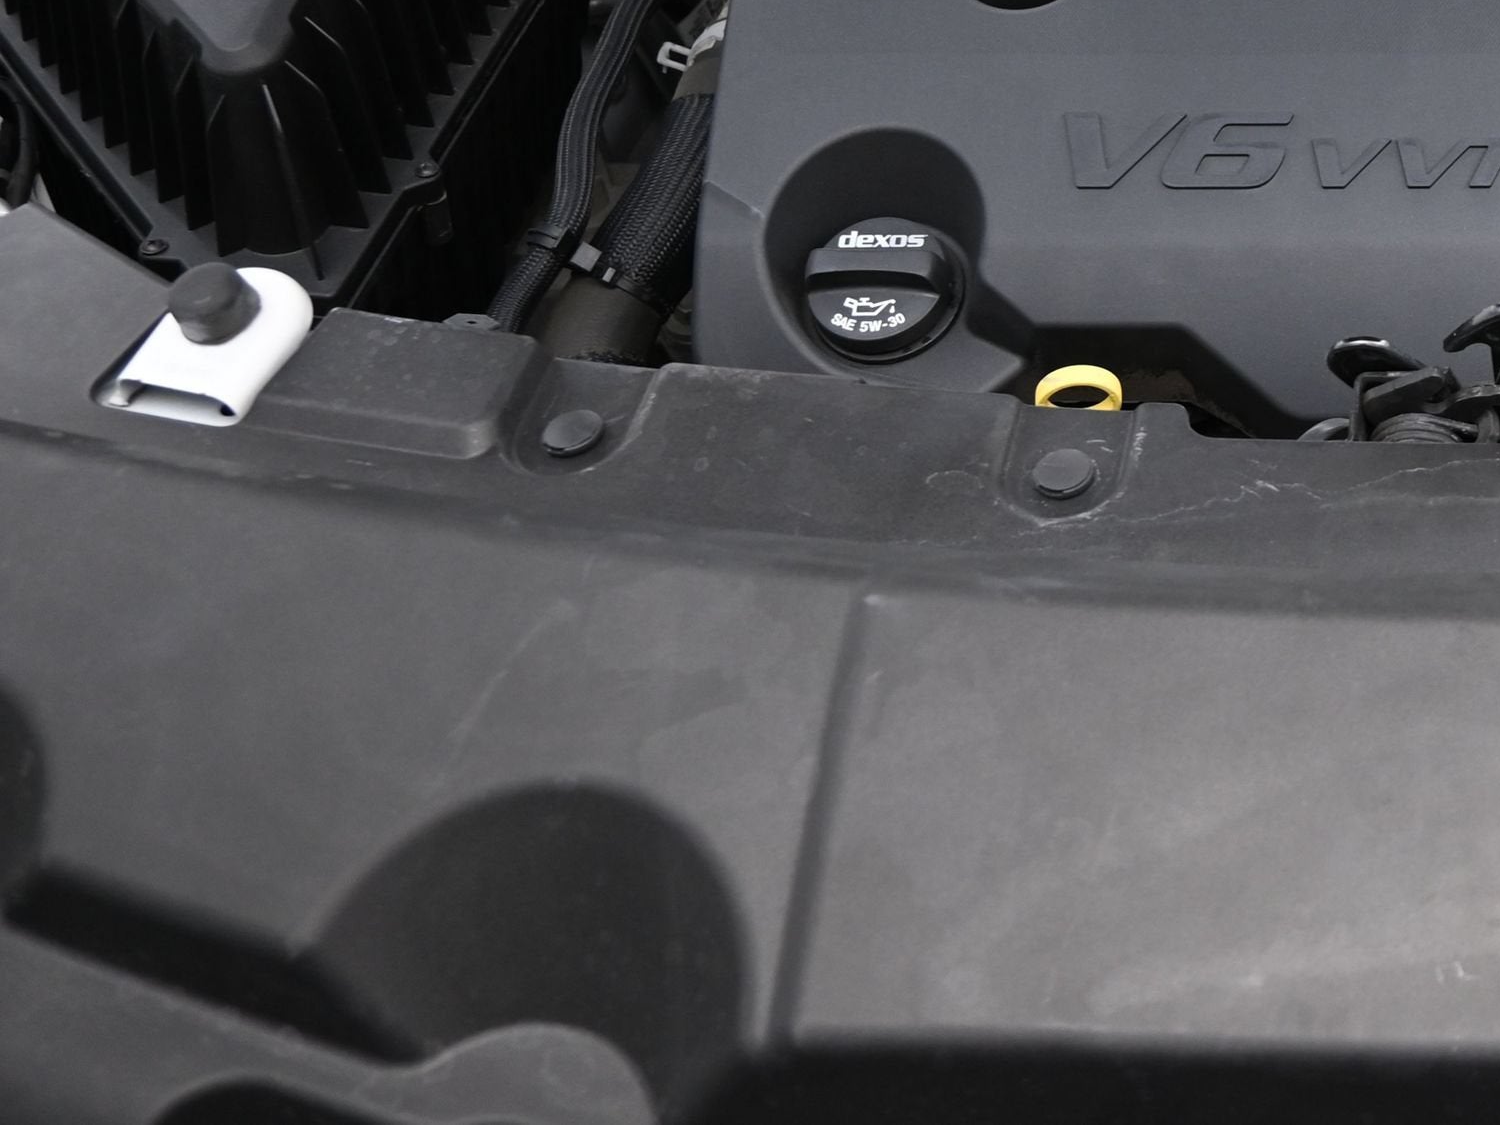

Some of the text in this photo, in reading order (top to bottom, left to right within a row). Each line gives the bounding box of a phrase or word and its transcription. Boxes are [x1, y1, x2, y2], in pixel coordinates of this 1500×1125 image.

[1062, 111, 1294, 189] V6
[837, 230, 928, 248] dexos
[830, 312, 906, 332] SAE 5W-30
